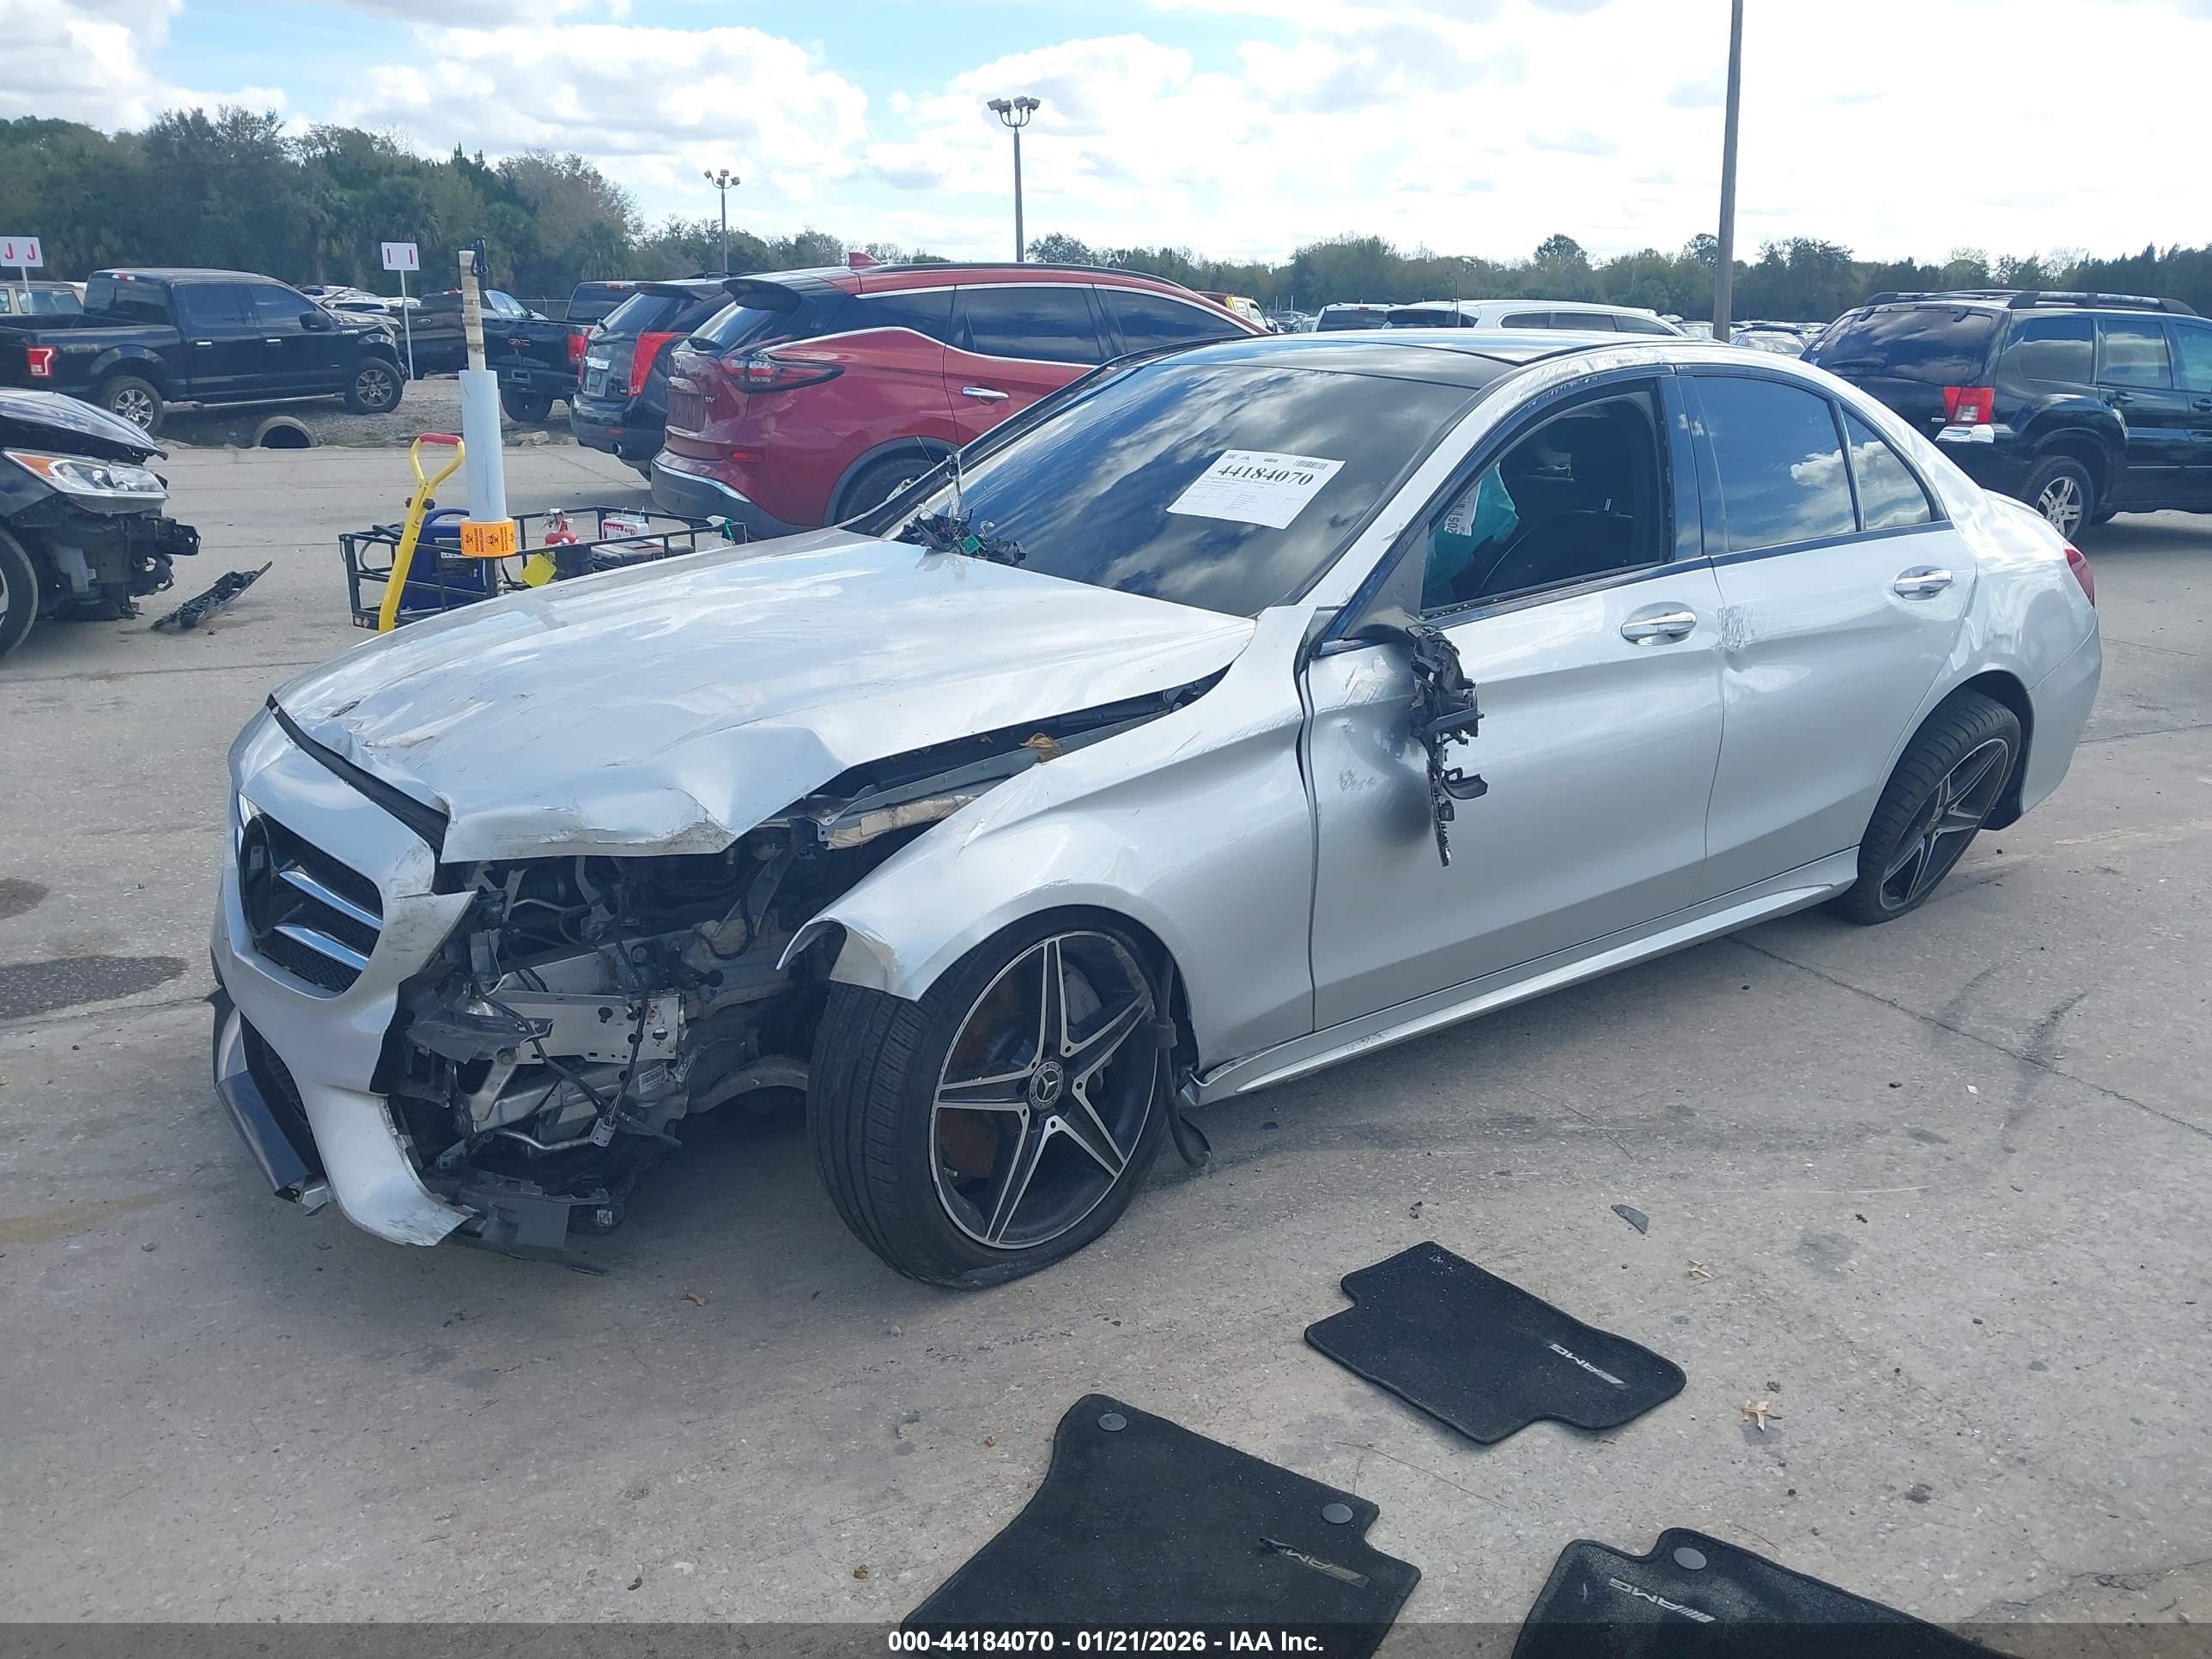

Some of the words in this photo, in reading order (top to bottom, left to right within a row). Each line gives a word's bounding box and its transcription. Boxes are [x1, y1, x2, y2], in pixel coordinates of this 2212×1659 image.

[4, 243, 14, 259] J
[27, 243, 36, 260] J
[1217, 465, 1315, 486] 44184070
